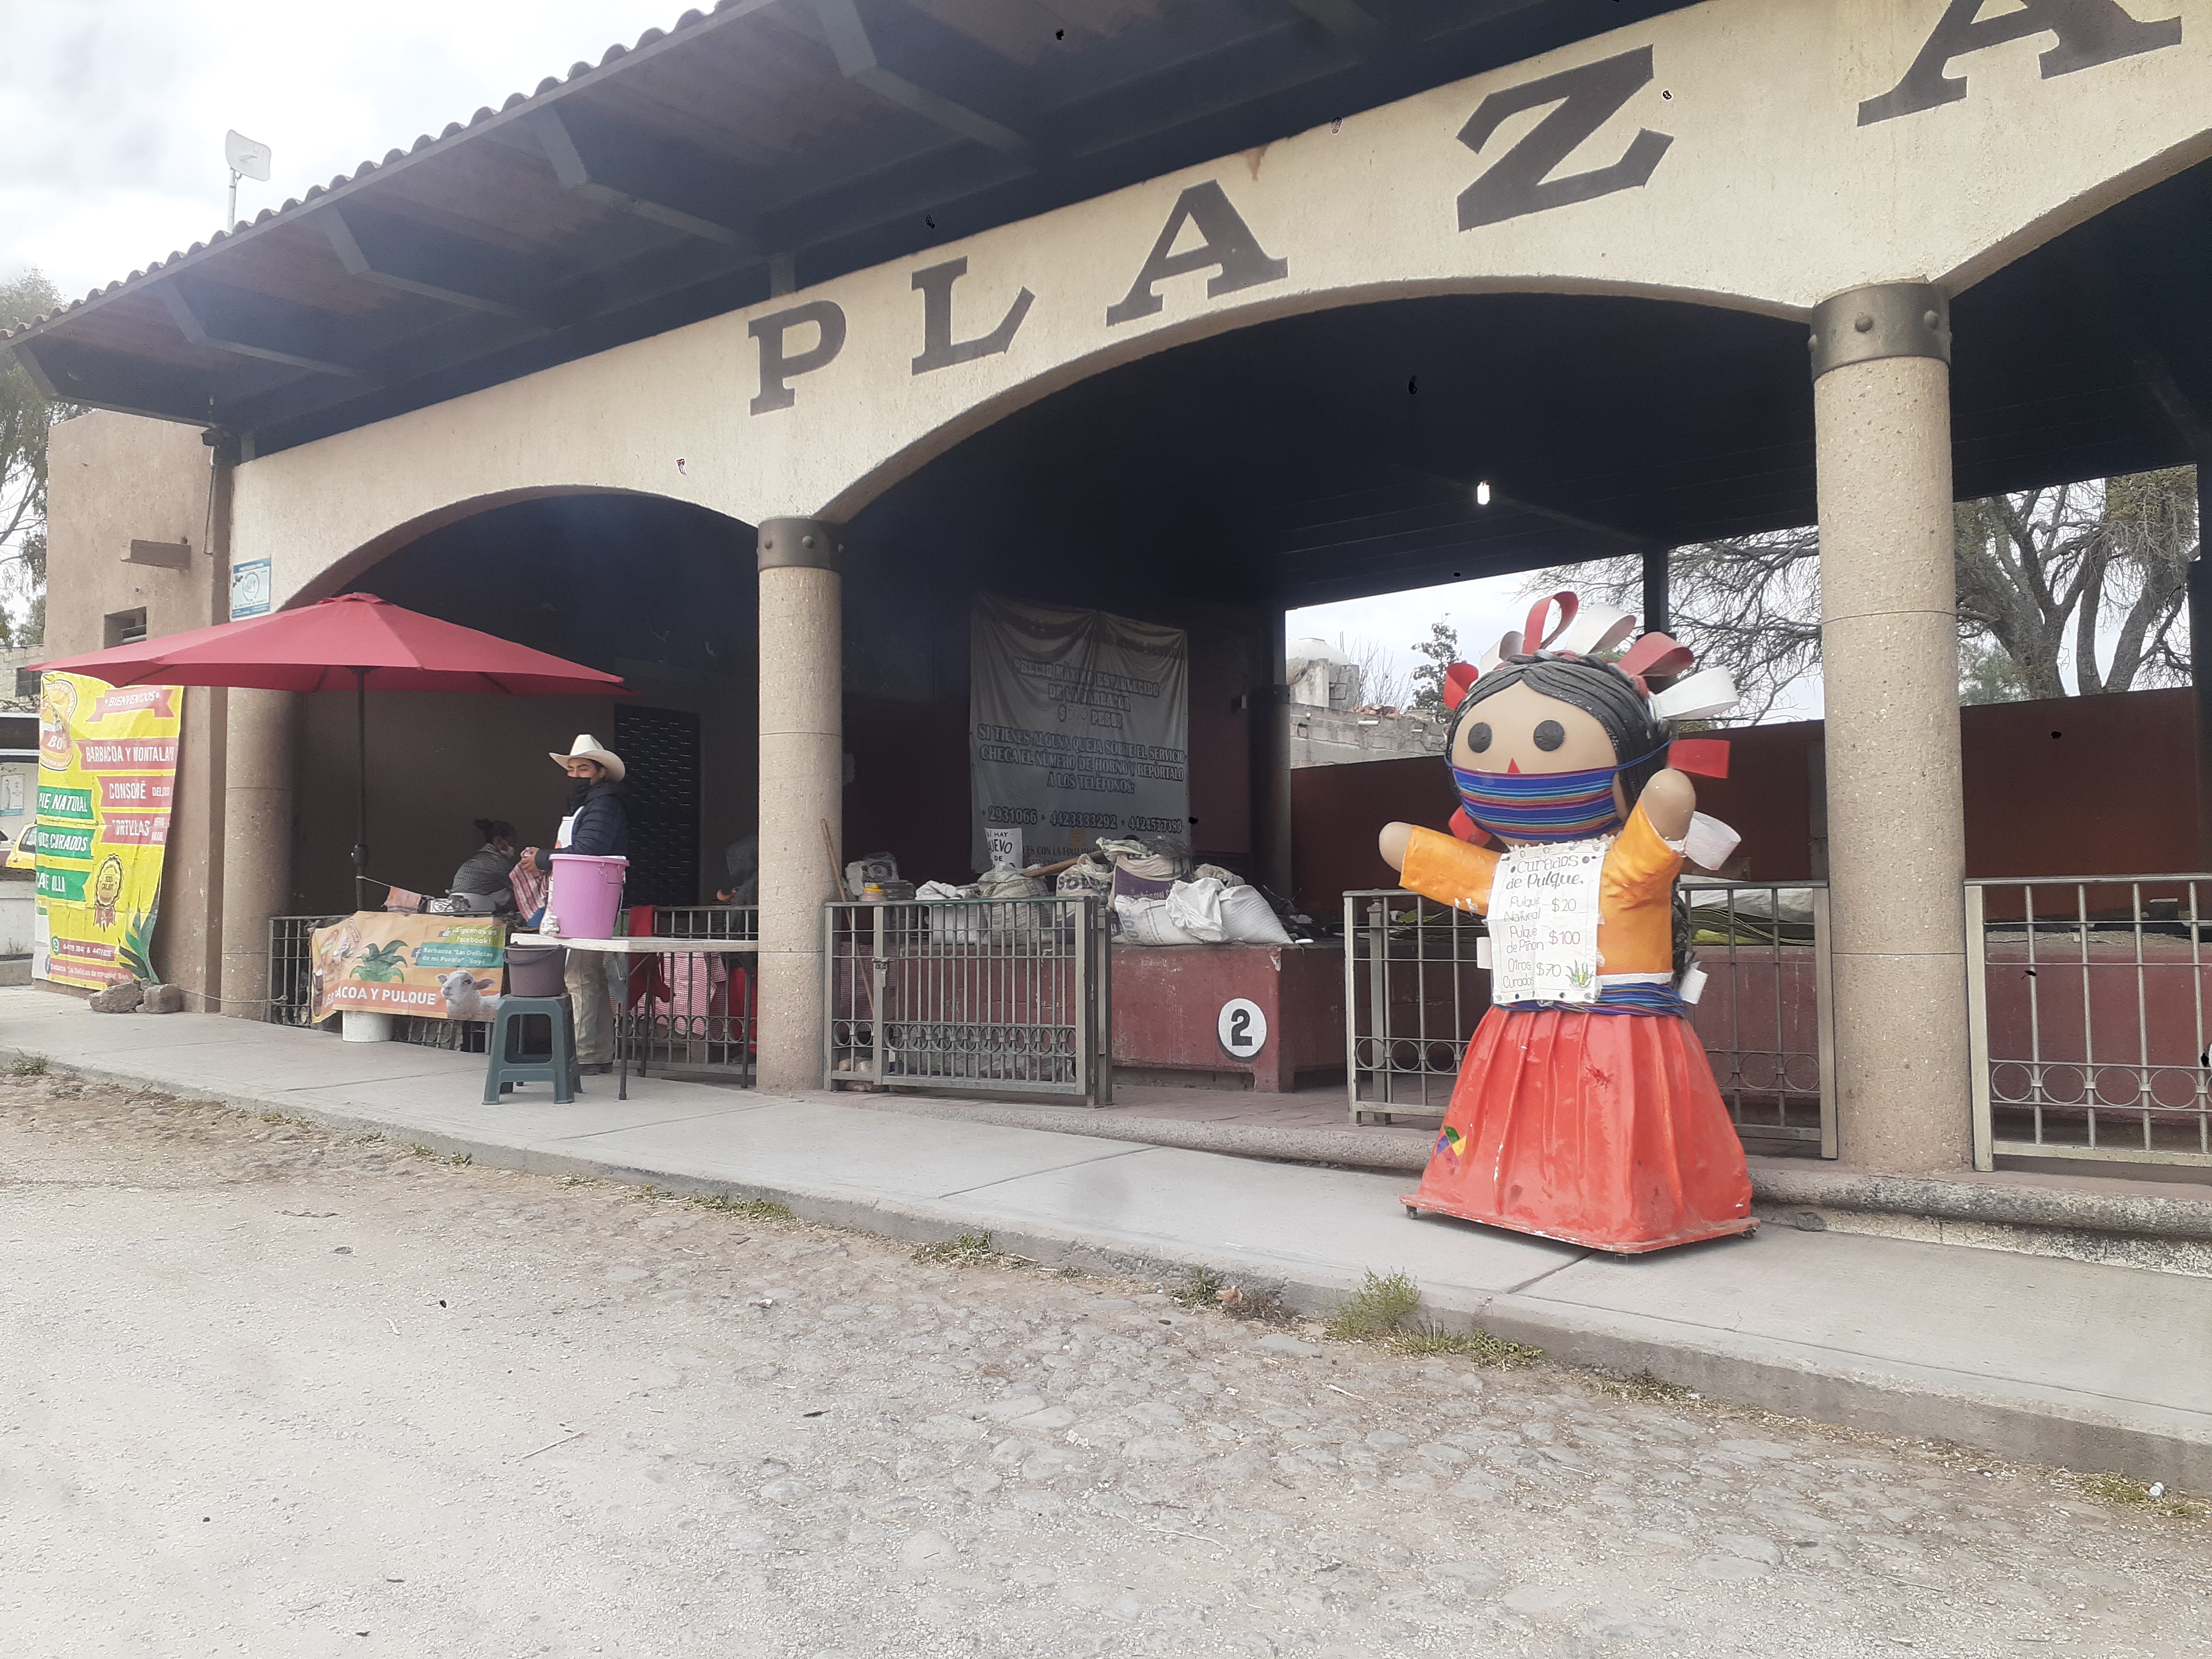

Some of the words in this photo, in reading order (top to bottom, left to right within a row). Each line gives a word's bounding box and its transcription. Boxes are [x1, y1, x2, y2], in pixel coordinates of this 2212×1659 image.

[748, 0, 2183, 416] PLAZA
[1049, 683, 1064, 700] DE
[1090, 709, 1123, 729] PESOS
[977, 723, 991, 741] SI
[993, 726, 1031, 747] TIENES
[1033, 731, 1071, 751] ALGUNA
[1072, 736, 1104, 754] QUEJA
[1104, 741, 1135, 758] SOBRE
[1135, 744, 1148, 760] EL
[1148, 745, 1185, 765] SERVICIO
[86, 746, 124, 762] BARBACOA
[125, 747, 131, 761] Y
[981, 745, 1019, 763] CHECA
[1020, 749, 1034, 766] EL
[1077, 755, 1094, 771] DE
[1094, 758, 1129, 775] HORNO
[1129, 761, 1137, 776] Y
[1047, 771, 1056, 787] A
[1057, 773, 1077, 790] LOS
[988, 805, 1037, 825] 2931066
[1049, 810, 1117, 829] 4423333292
[1506, 877, 1522, 890] de
[1509, 896, 1540, 908] Pulque
[1551, 898, 1577, 912] $20
[1504, 910, 1541, 923] Natural
[1509, 925, 1537, 939] Pulque
[1549, 930, 1581, 945] $100
[424, 947, 452, 955] Barbacoa
[466, 950, 494, 958] Delicias
[1506, 942, 1518, 954] de
[1508, 958, 1531, 973] Otros
[1536, 962, 1562, 978] $70
[1503, 975, 1534, 989] Curados
[370, 988, 379, 1000] Y
[382, 989, 437, 1005] PULQUE
[1231, 1008, 1253, 1046] 2
